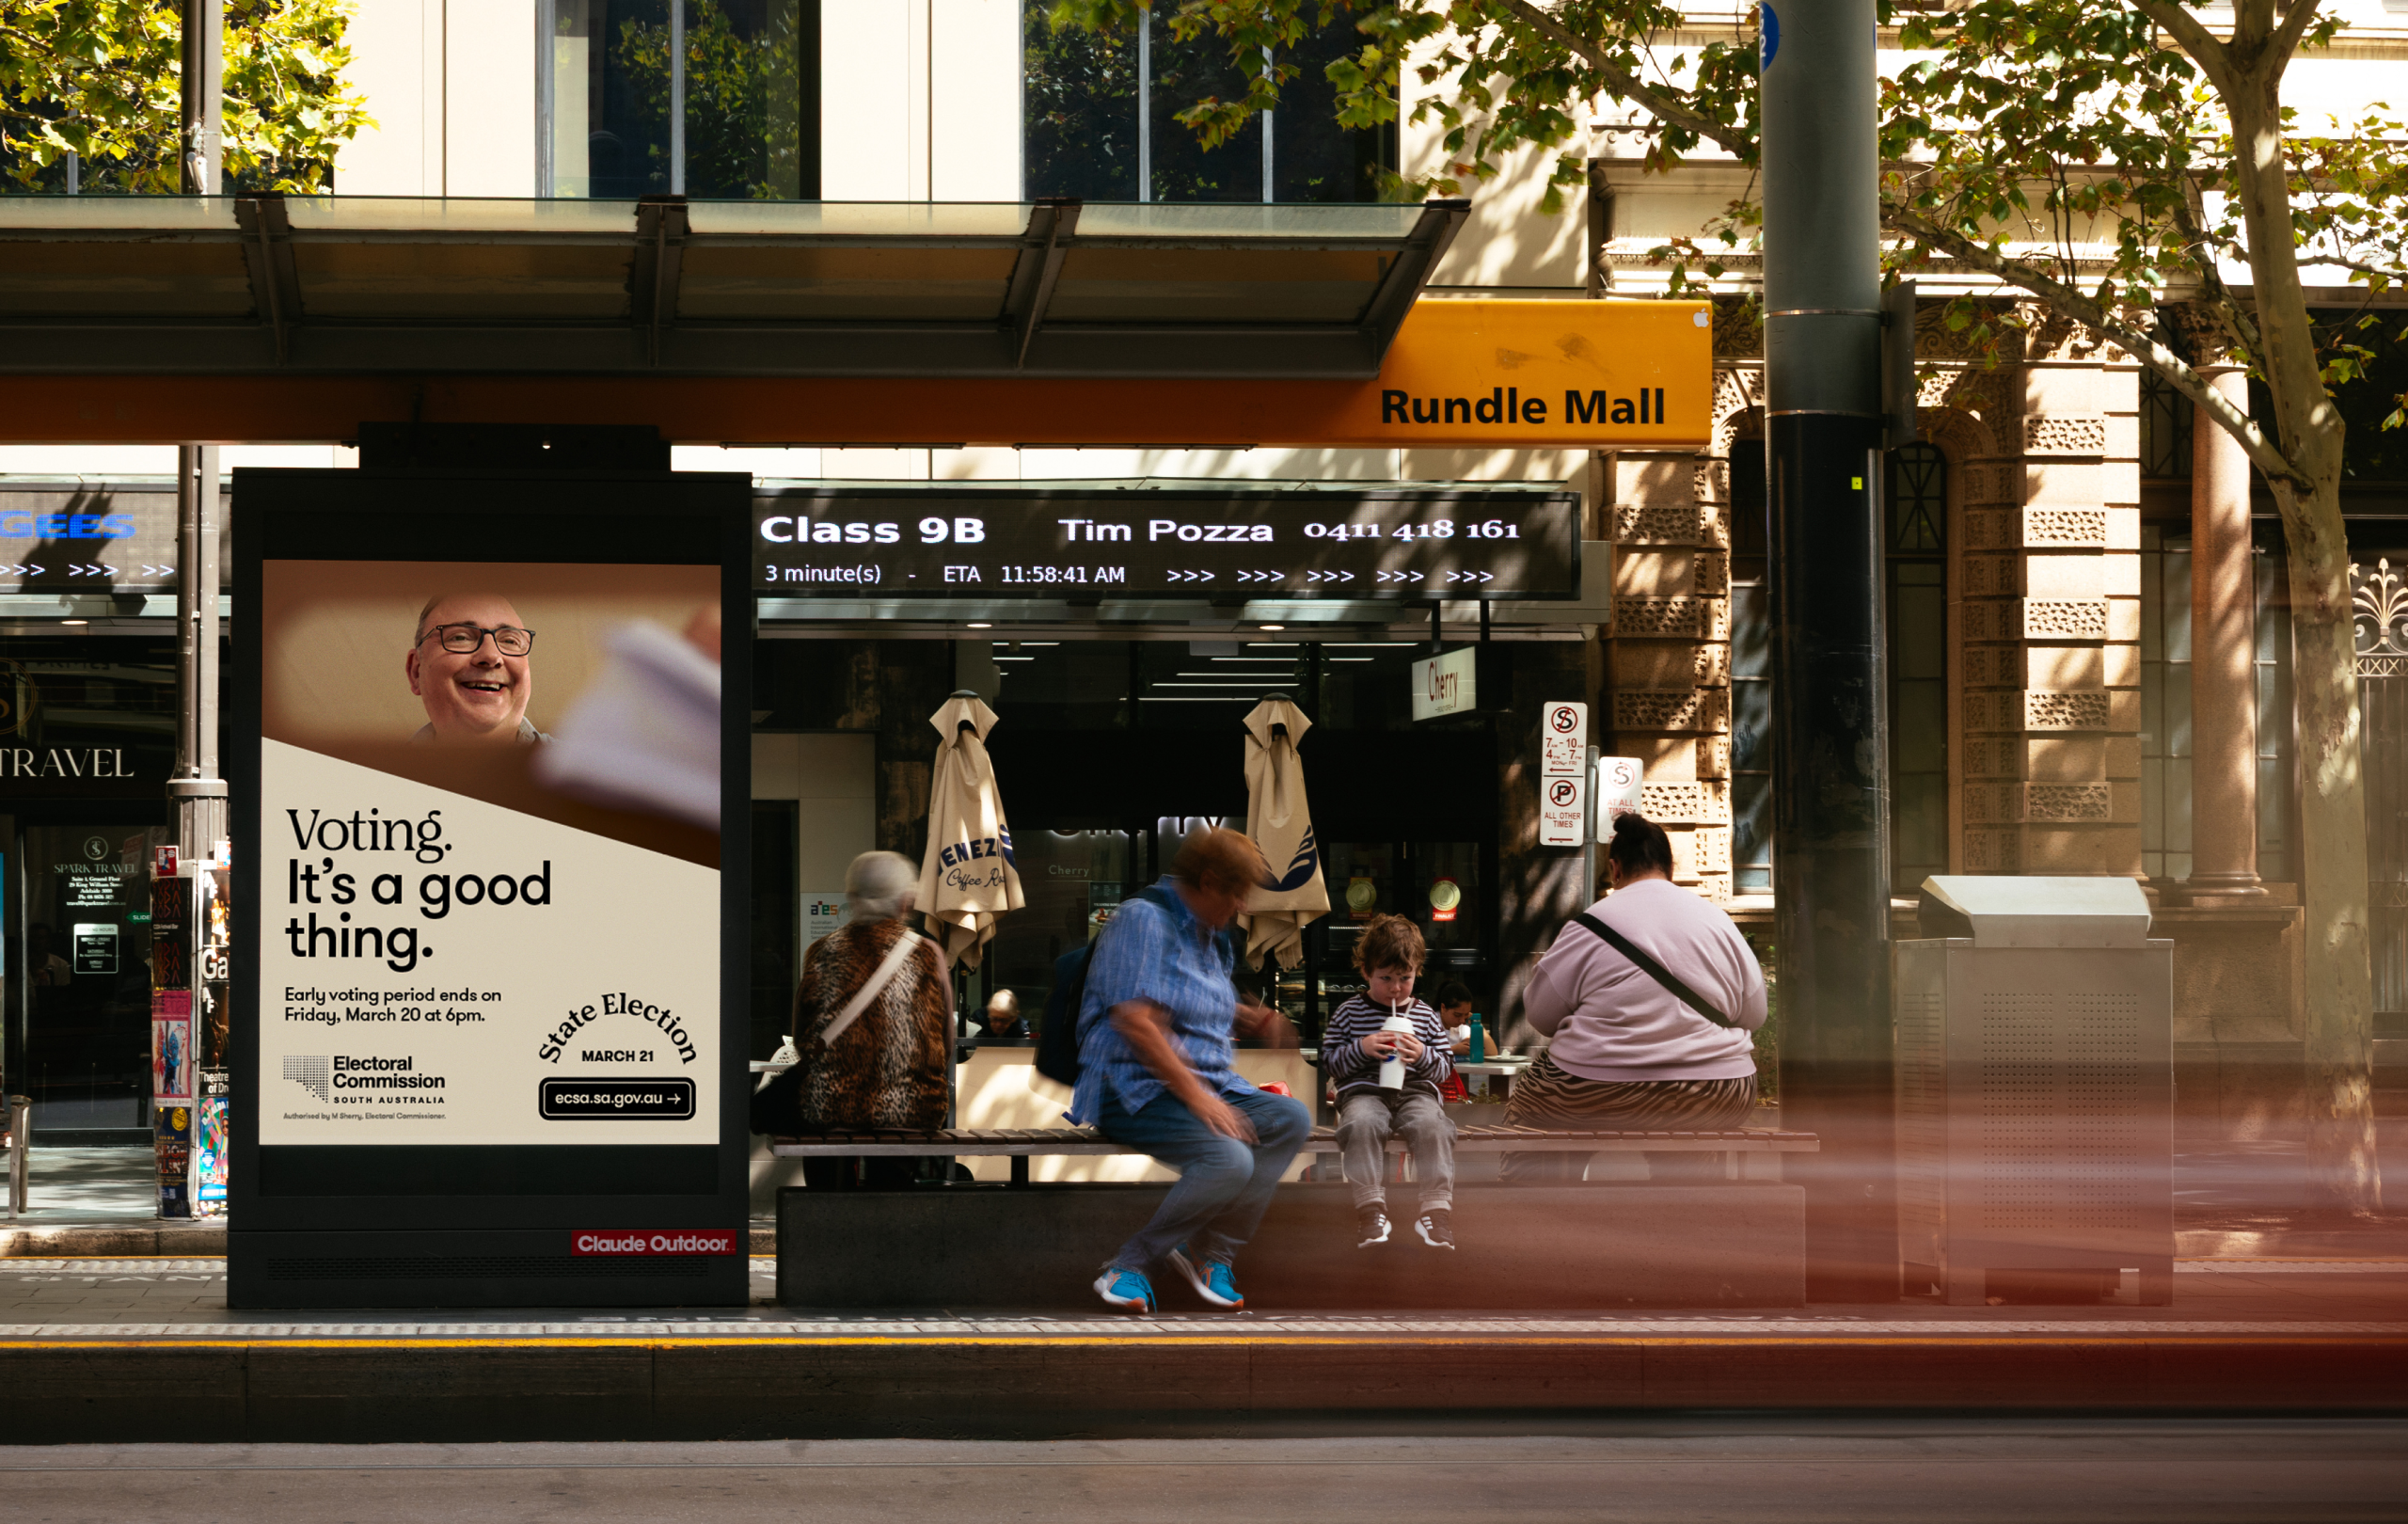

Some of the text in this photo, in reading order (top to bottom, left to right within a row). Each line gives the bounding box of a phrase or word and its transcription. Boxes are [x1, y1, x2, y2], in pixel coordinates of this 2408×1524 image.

[1381, 387, 1664, 425] Rundle Mall
[761, 516, 1520, 543] Class 9B Tim Pozza 0411 418 161
[766, 565, 777, 581] 3
[784, 564, 881, 584] minute(s)
[943, 566, 981, 582] ETA
[1002, 566, 1088, 582] 11:58:41
[1094, 566, 1125, 582] AM
[1429, 660, 1458, 708] Cherry
[286, 808, 452, 864] Voting.
[54, 864, 138, 874] SPARK TRAVEL
[1048, 865, 1089, 878] Cherry
[946, 867, 982, 891] Coffee
[288, 857, 551, 920] It’s a good
[285, 912, 434, 973] thing.
[285, 987, 502, 1006] Early voting period ends on
[285, 1008, 485, 1026] Friday, March 20 at 6pm.
[539, 992, 698, 1065] State Election
[333, 1056, 412, 1072] Electoral
[582, 1051, 654, 1062] MARCH 21
[198, 1072, 230, 1083] Theatre
[333, 1073, 446, 1089] Commission
[208, 1083, 217, 1093] of
[333, 1096, 445, 1104] SOUTH AUSTRALIA
[555, 1094, 663, 1108] ecsa.sa.gov.au
[321, 1112, 330, 1121] by
[578, 1235, 729, 1252] Claude Outdoor
